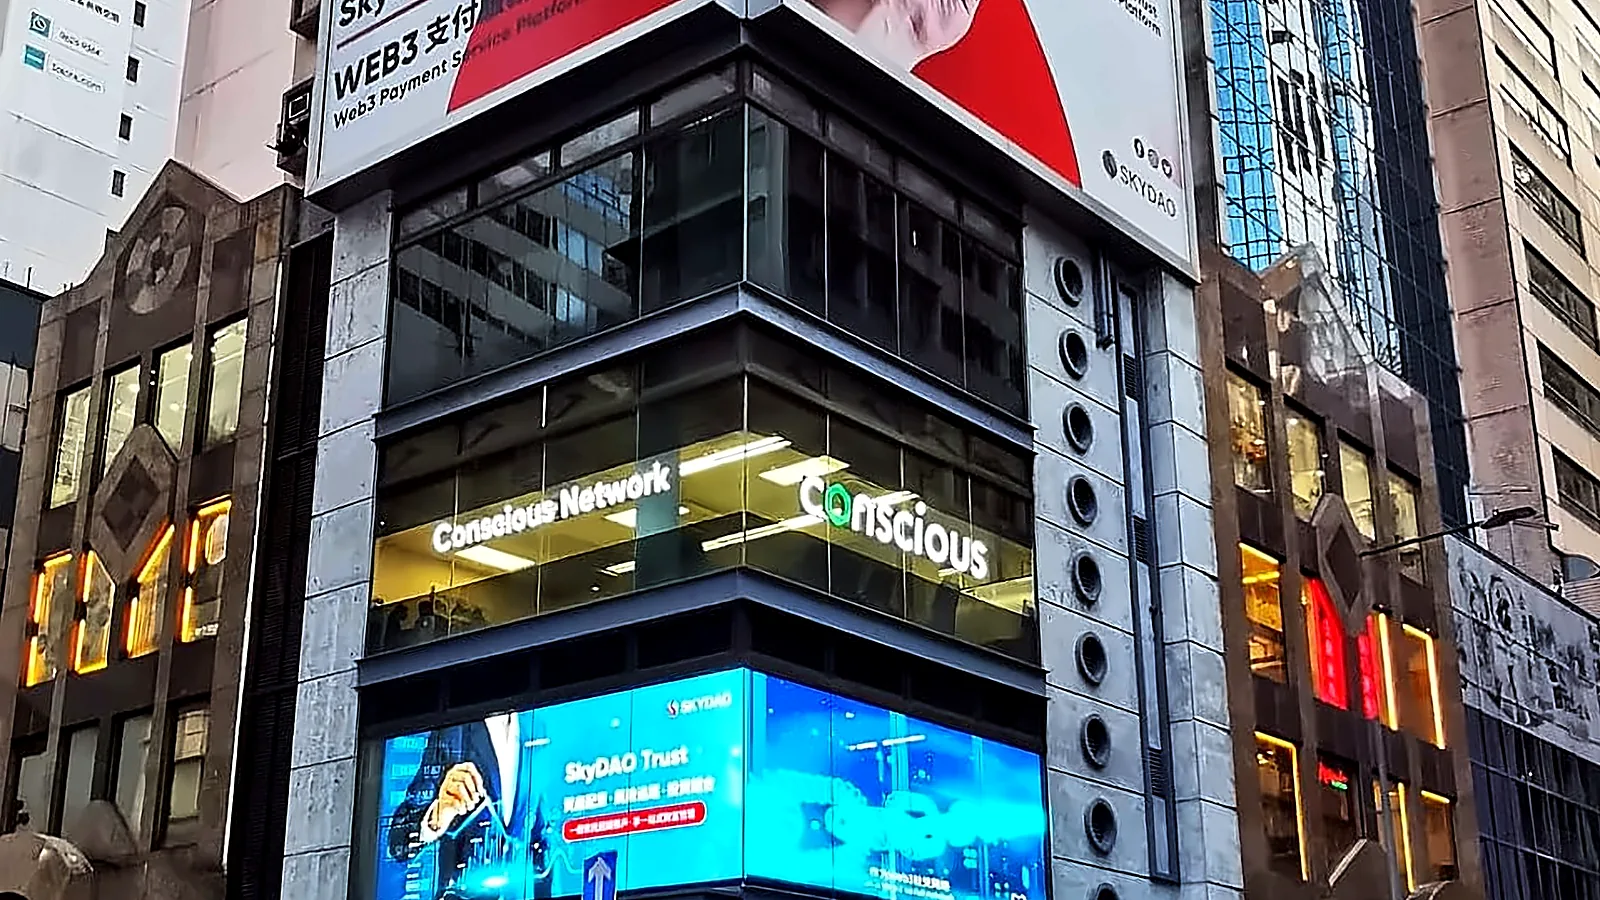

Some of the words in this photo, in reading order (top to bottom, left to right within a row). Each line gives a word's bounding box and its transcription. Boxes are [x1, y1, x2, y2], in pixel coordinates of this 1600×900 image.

[333, 29, 419, 100] WEB3
[333, 95, 377, 130] Web3
[379, 60, 448, 107] Payment
[1119, 164, 1177, 218] SKYDAO
[432, 498, 557, 554] Conscious
[558, 459, 672, 520] Network
[800, 475, 990, 581] Conscious
[563, 751, 638, 785] SkyDAO
[640, 744, 690, 772] Trust
